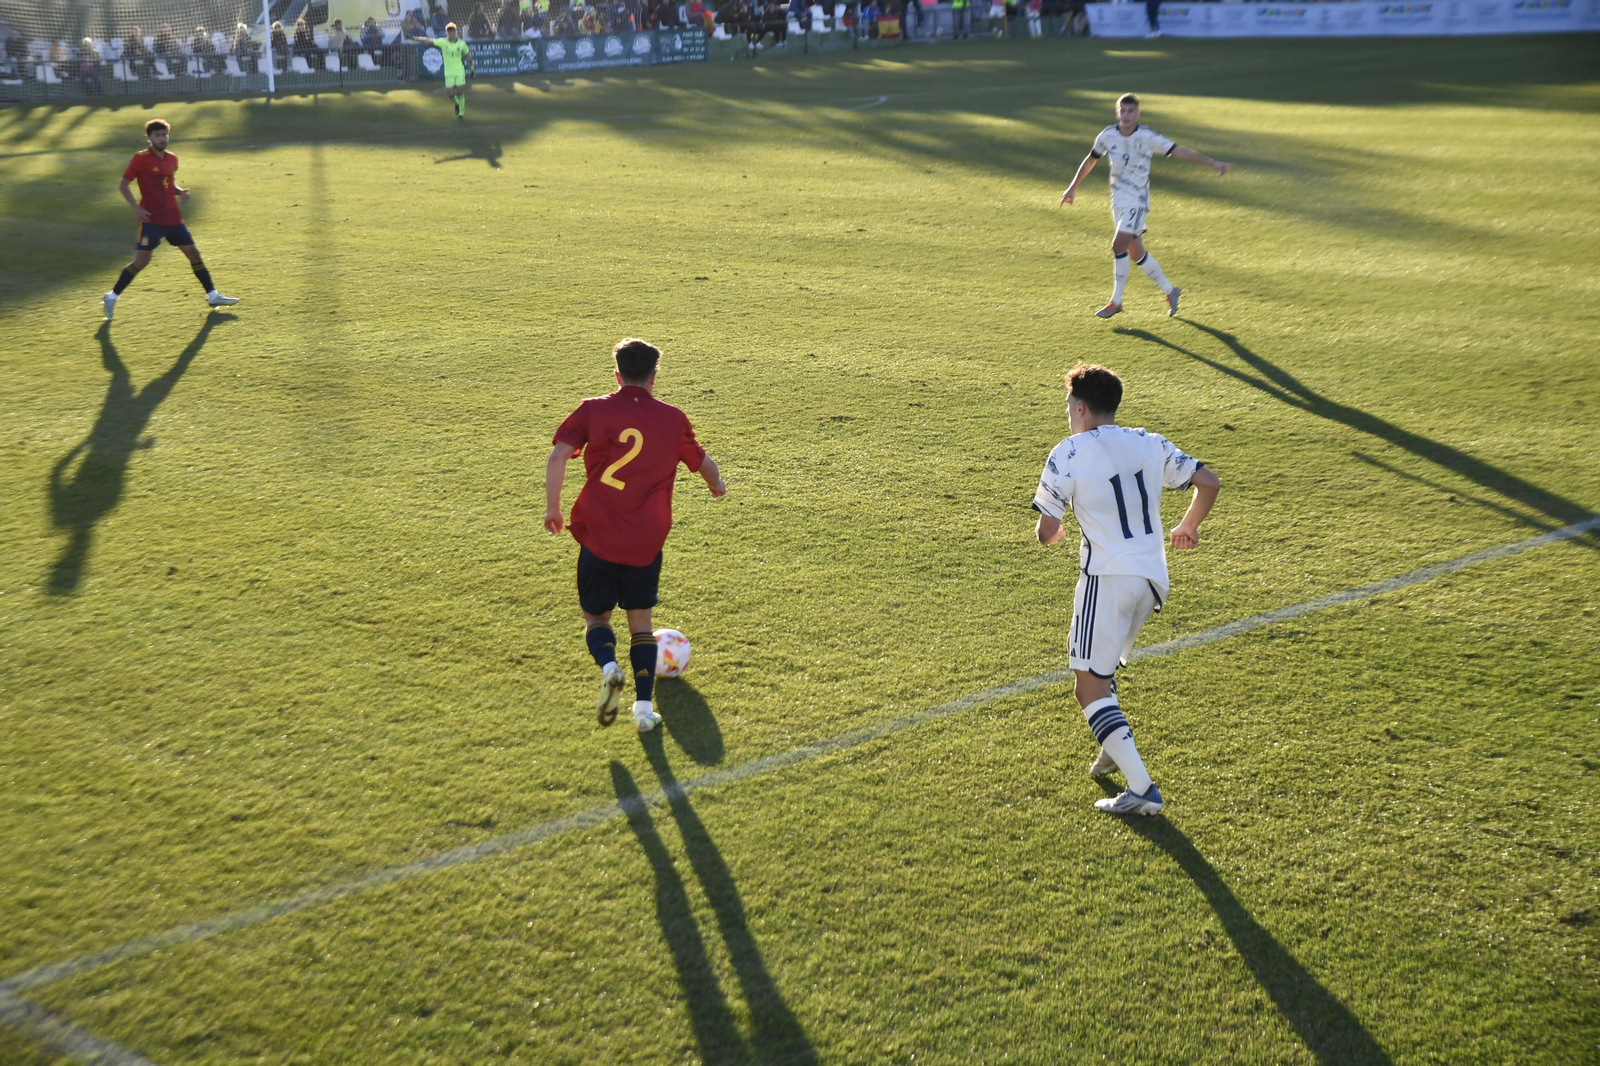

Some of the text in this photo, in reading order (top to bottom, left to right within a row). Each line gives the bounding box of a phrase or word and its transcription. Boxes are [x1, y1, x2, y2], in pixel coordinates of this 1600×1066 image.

[1122, 153, 1130, 166] 9
[1129, 207, 1137, 221] 9
[600, 427, 644, 491] 2
[1108, 469, 1154, 540] 11
